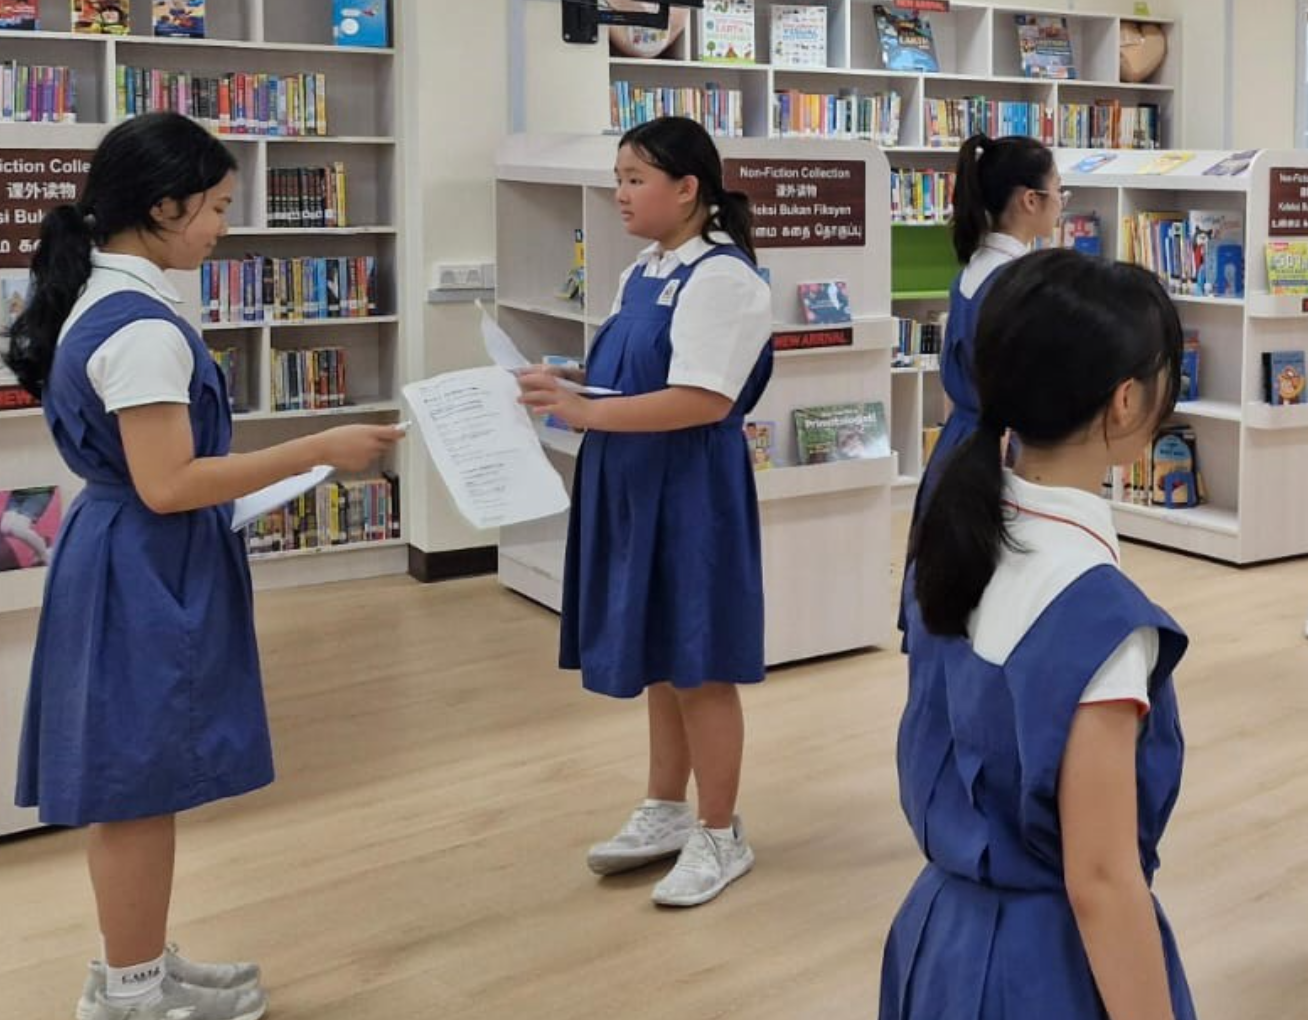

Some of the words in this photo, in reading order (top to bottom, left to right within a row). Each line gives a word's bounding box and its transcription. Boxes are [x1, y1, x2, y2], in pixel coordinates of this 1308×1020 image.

[0, 158, 45, 173] iction
[49, 158, 91, 174] Colle
[740, 166, 799, 178] Non-Fiction
[801, 167, 851, 179] Collection
[6, 181, 76, 199] 课外读物
[14, 208, 45, 224] Buk
[753, 204, 777, 216] leksi
[779, 204, 812, 216] Bukan
[814, 204, 851, 218] Fiksyen
